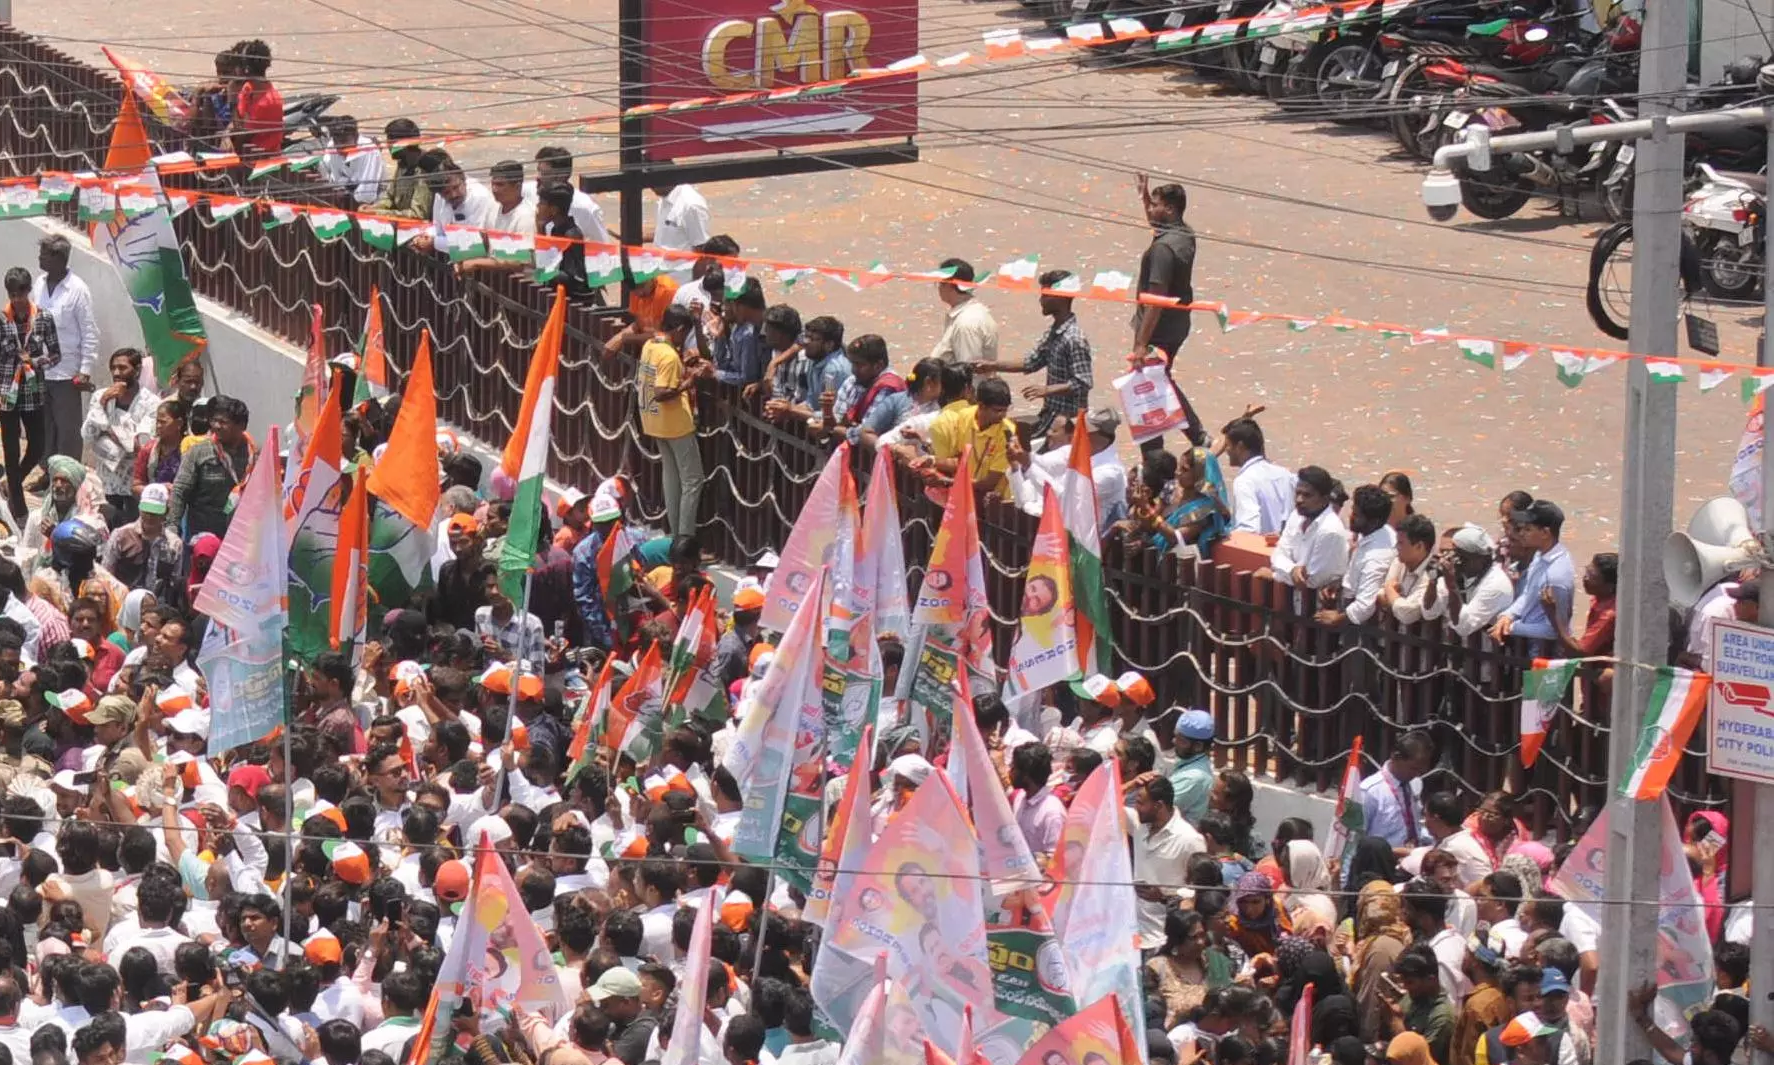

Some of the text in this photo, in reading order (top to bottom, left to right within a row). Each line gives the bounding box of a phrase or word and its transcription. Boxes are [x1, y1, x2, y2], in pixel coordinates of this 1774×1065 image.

[702, 10, 871, 90] CMR
[1722, 632, 1748, 647] AREA
[1716, 736, 1774, 758] CITY POLI
